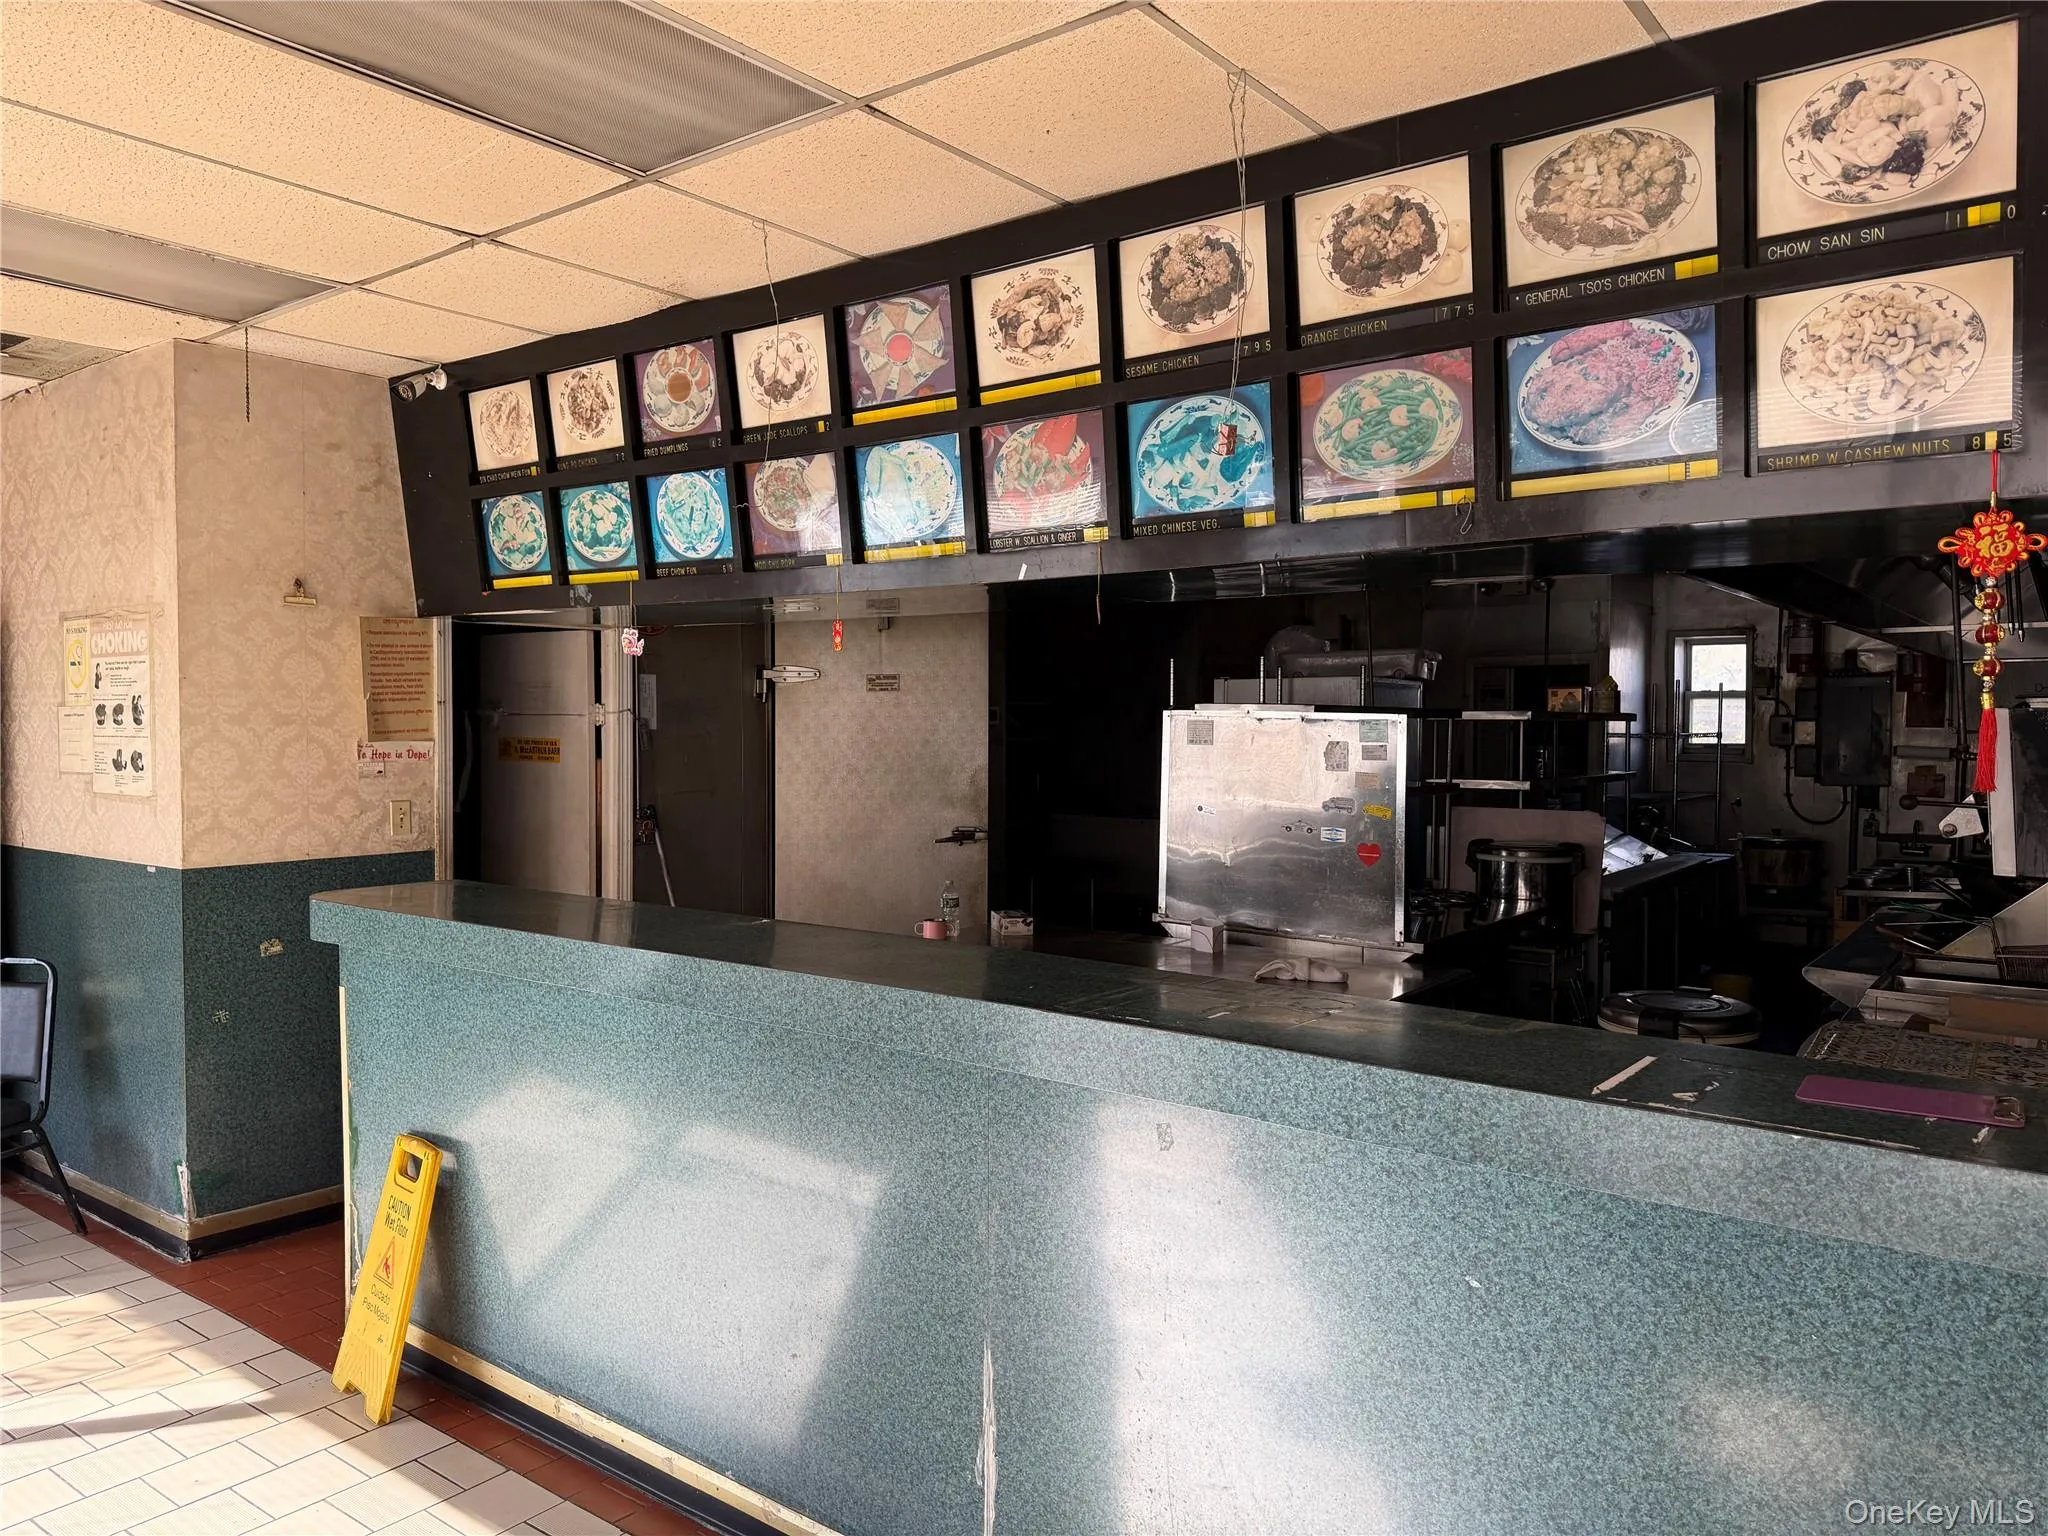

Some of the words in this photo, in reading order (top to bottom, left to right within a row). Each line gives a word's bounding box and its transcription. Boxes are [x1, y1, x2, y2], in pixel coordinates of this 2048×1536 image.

[1768, 240, 1811, 260] CHOW
[1820, 233, 1851, 250] SAN
[1860, 226, 1885, 243] SIN
[1525, 286, 1572, 306] GENERAL
[1579, 278, 1612, 296] TSO'S
[1618, 268, 1665, 288] CHICKEN
[1300, 328, 1339, 347] ORANGE
[1344, 319, 1387, 338] CHICKEN
[1126, 362, 1158, 378] SESAME
[1162, 355, 1200, 371] CHICKEN
[743, 433, 761, 444] GREEN
[780, 425, 808, 439] SCALLOPS
[644, 448, 658, 457] FRIED
[660, 443, 688, 455] DUMPLINGS
[1767, 453, 1819, 471] SHRIMP
[1844, 444, 1906, 462] CASHEW
[1912, 439, 1950, 455] NUTS
[1133, 524, 1158, 537] MIXED
[1161, 520, 1197, 534] CHINESE
[1200, 518, 1221, 530] VEG.
[990, 537, 1013, 549] LOBSTER
[1023, 534, 1048, 546] SCALLION
[1051, 533, 1056, 543] &
[1058, 531, 1077, 542] GINGER
[1975, 523, 2015, 559] 福
[656, 568, 669, 577] BEEF
[670, 567, 685, 576] CHOW
[686, 567, 697, 575] FUN
[91, 630, 148, 656] CHOKING
[371, 748, 391, 761] Hope
[406, 748, 431, 761] Dope!
[388, 1195, 412, 1222] CAUTION
[384, 1211, 395, 1233] Wet
[395, 1216, 409, 1239] Floor
[370, 1283, 391, 1306] Cuidado
